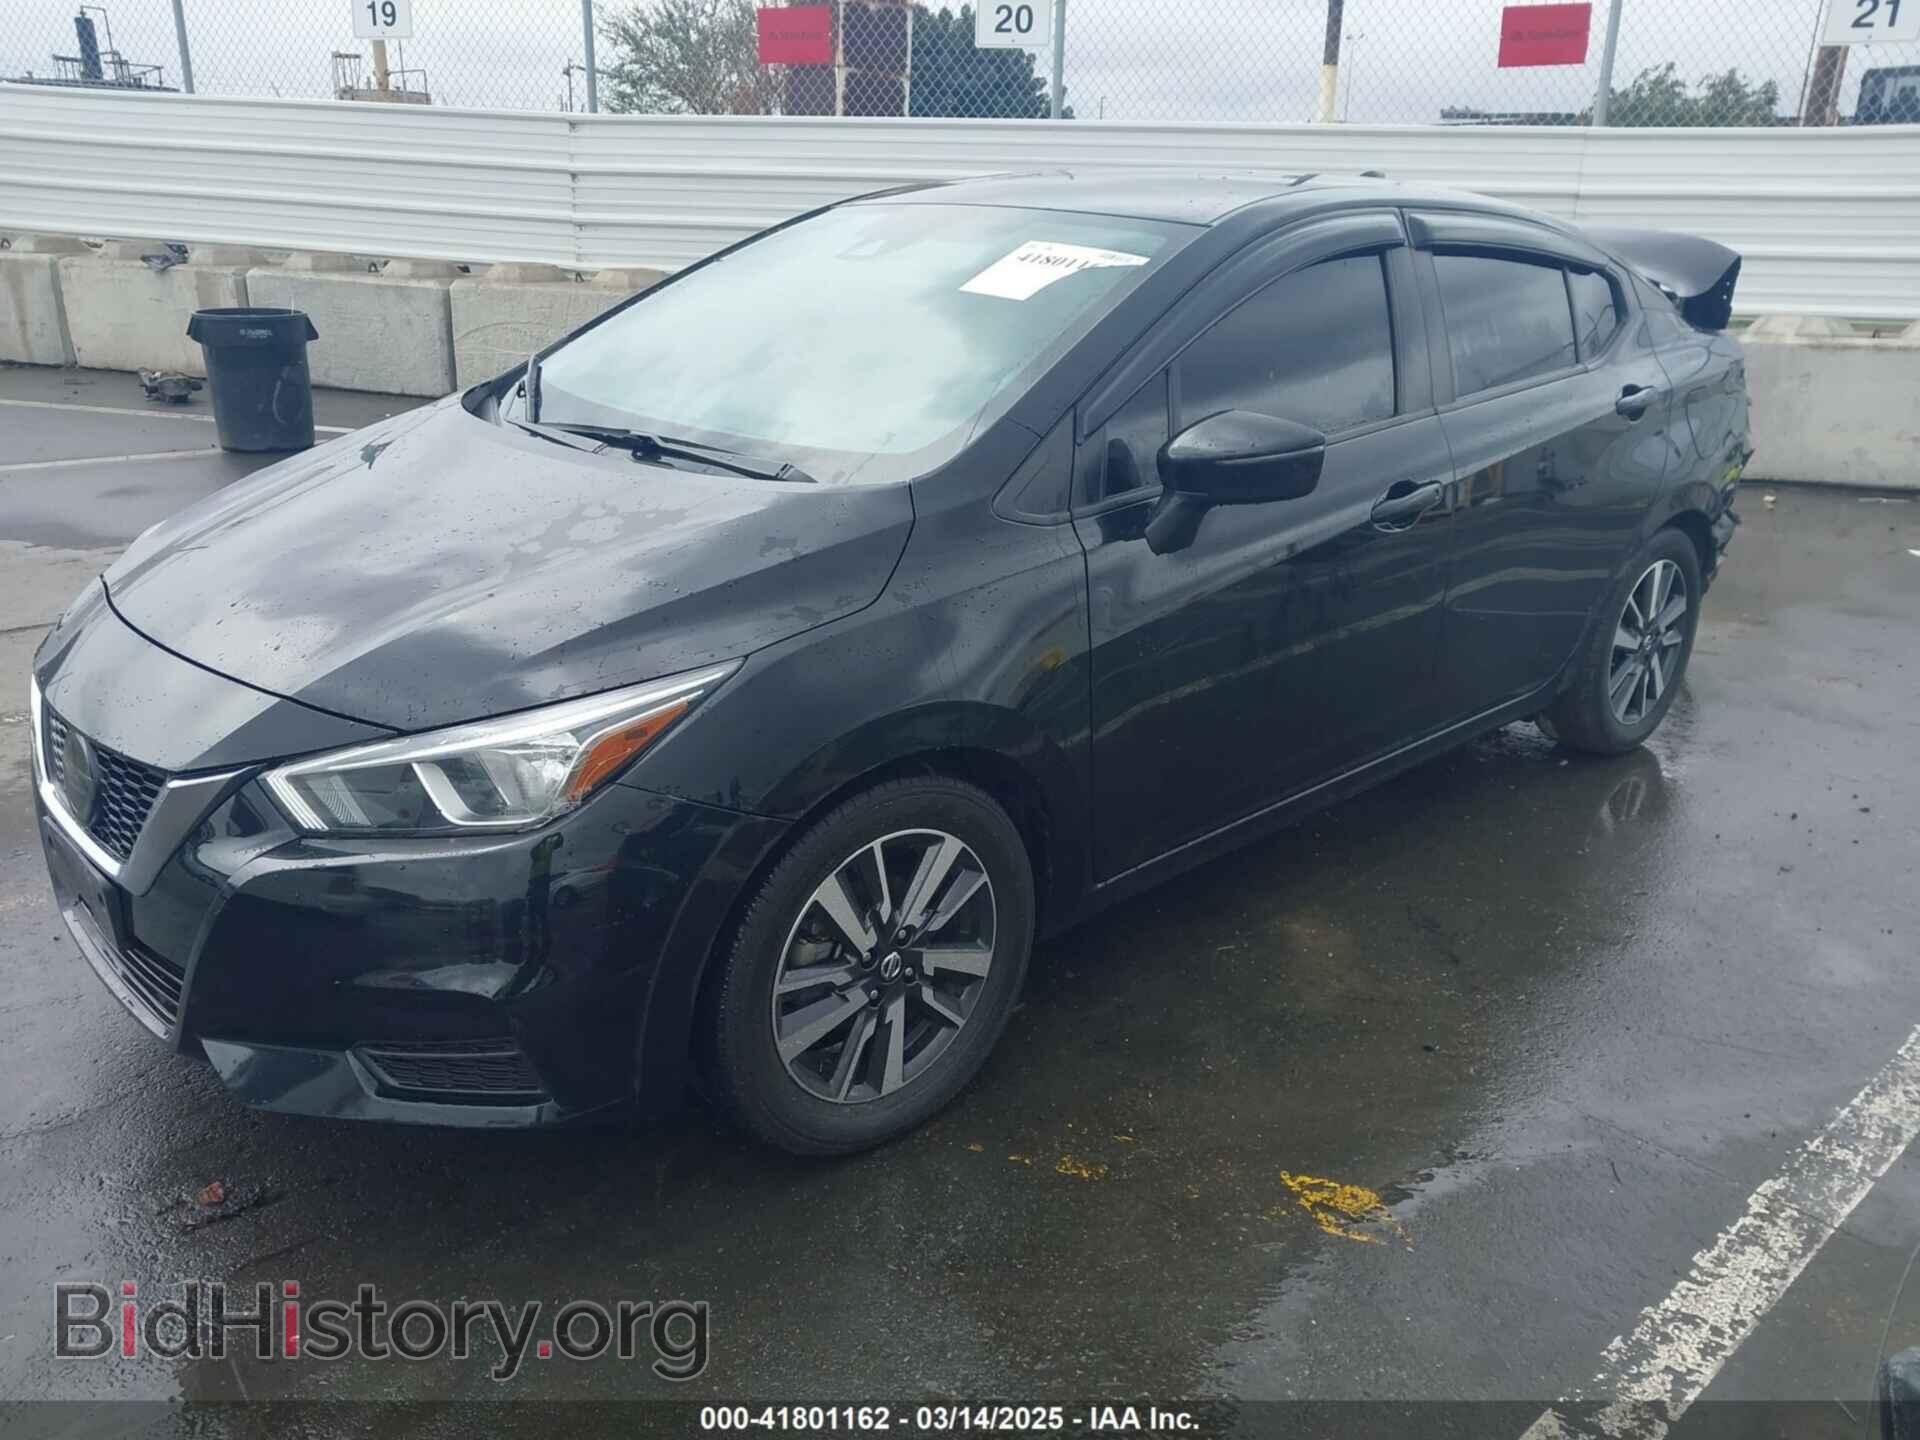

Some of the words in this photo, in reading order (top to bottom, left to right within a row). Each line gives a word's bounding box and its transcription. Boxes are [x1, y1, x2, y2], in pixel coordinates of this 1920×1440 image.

[366, 0, 397, 27] 19
[994, 4, 1033, 33] 20
[1850, 0, 1901, 28] 21
